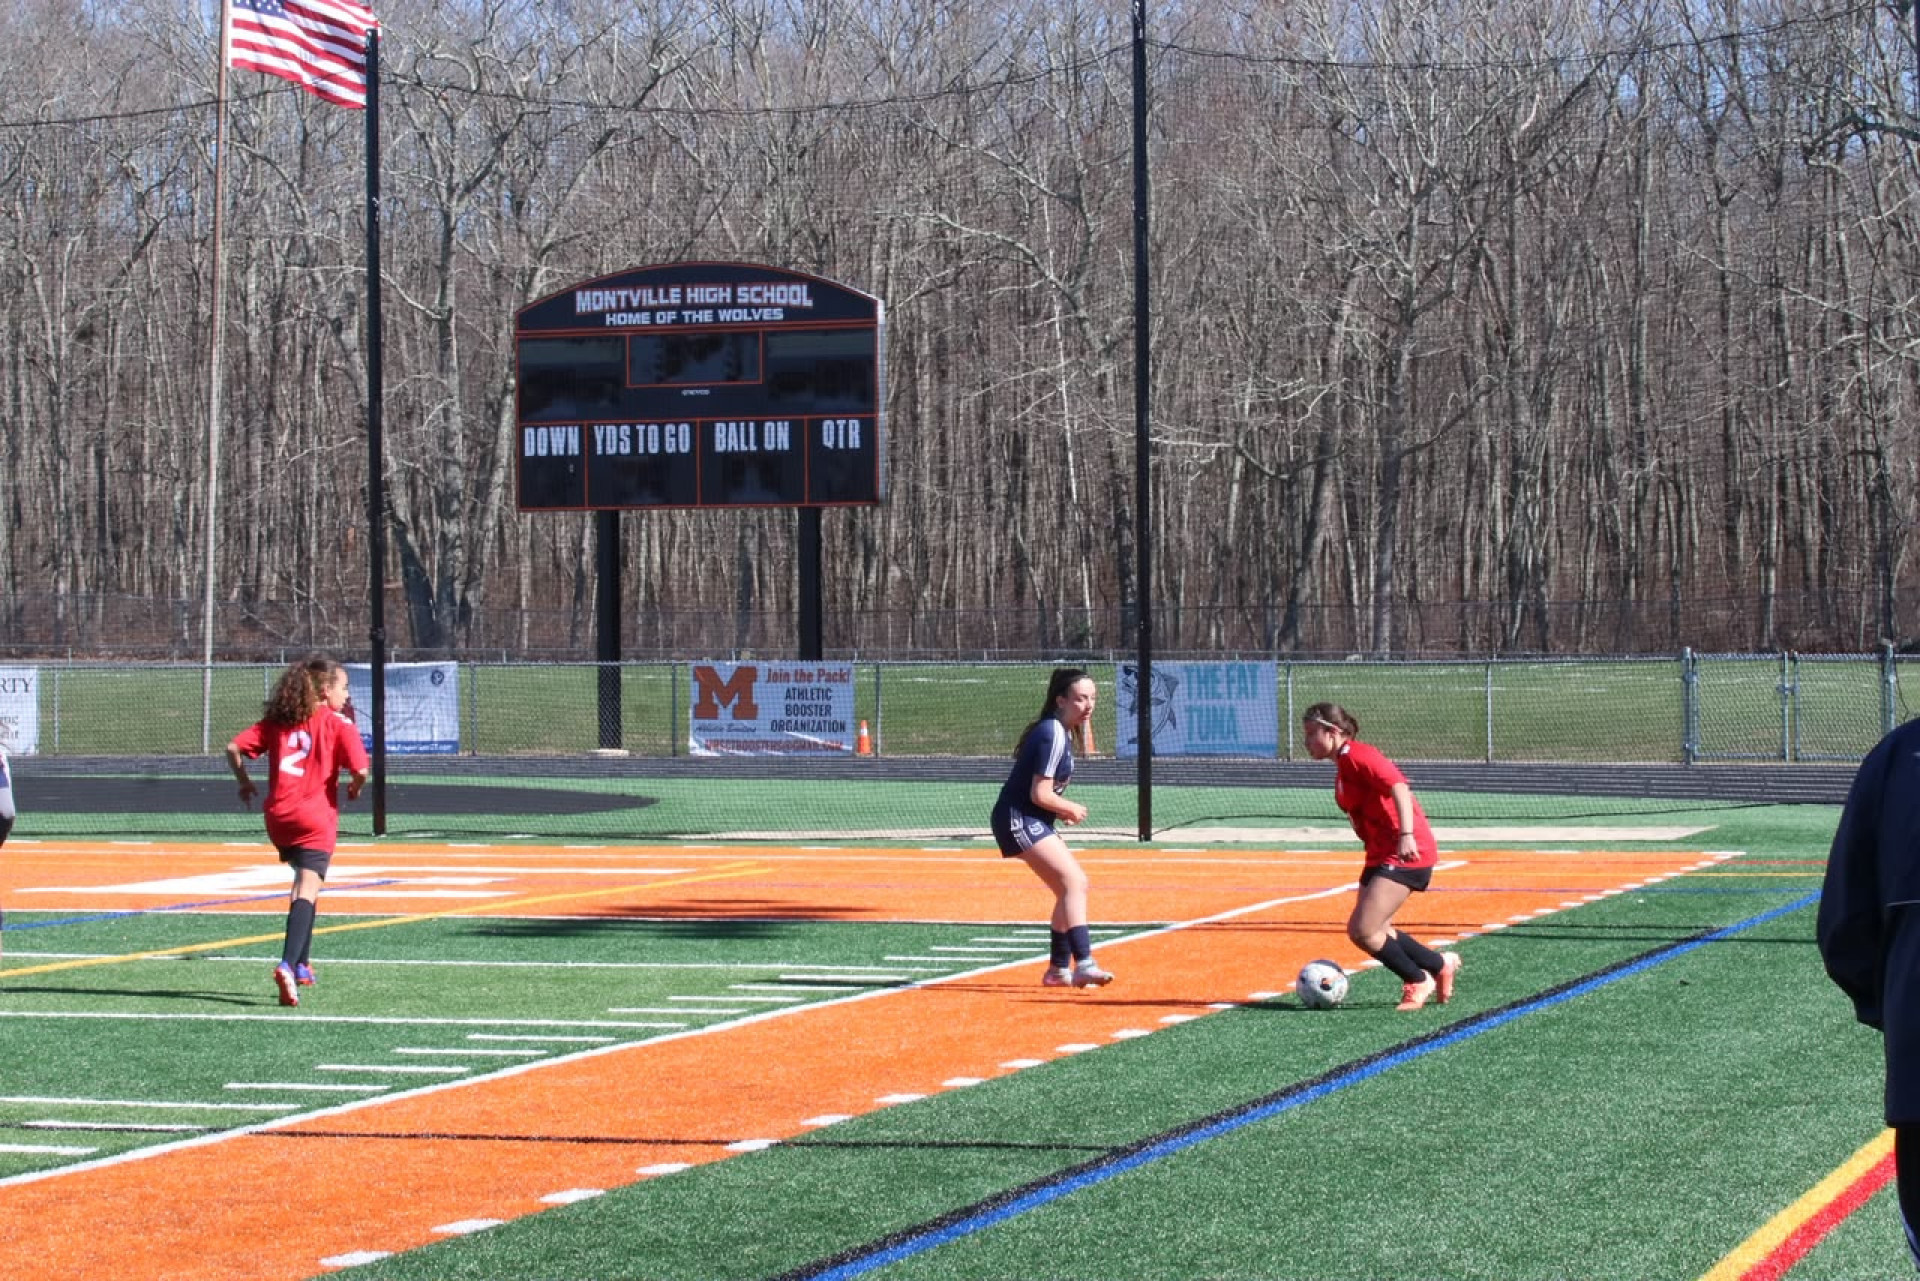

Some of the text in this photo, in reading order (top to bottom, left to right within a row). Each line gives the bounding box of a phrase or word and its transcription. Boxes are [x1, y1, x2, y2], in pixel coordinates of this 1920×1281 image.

[576, 283, 813, 313] MONTVILLE HIGH SCHOOL
[605, 308, 784, 326] HOME OF THE WOLVES
[524, 425, 580, 457] DOWN
[594, 423, 691, 456] YDS TO GO
[714, 421, 790, 452] BALL ON
[822, 419, 861, 450] QTR
[767, 668, 851, 684] Join the Pack!
[1186, 664, 1260, 698] THE FAT
[694, 666, 757, 719] M
[785, 687, 833, 702] ATHLETIC
[770, 719, 846, 733] ORGANIZATION
[785, 704, 832, 718] BOOSTER
[1186, 705, 1238, 741] TUNA
[279, 729, 313, 777] 2
